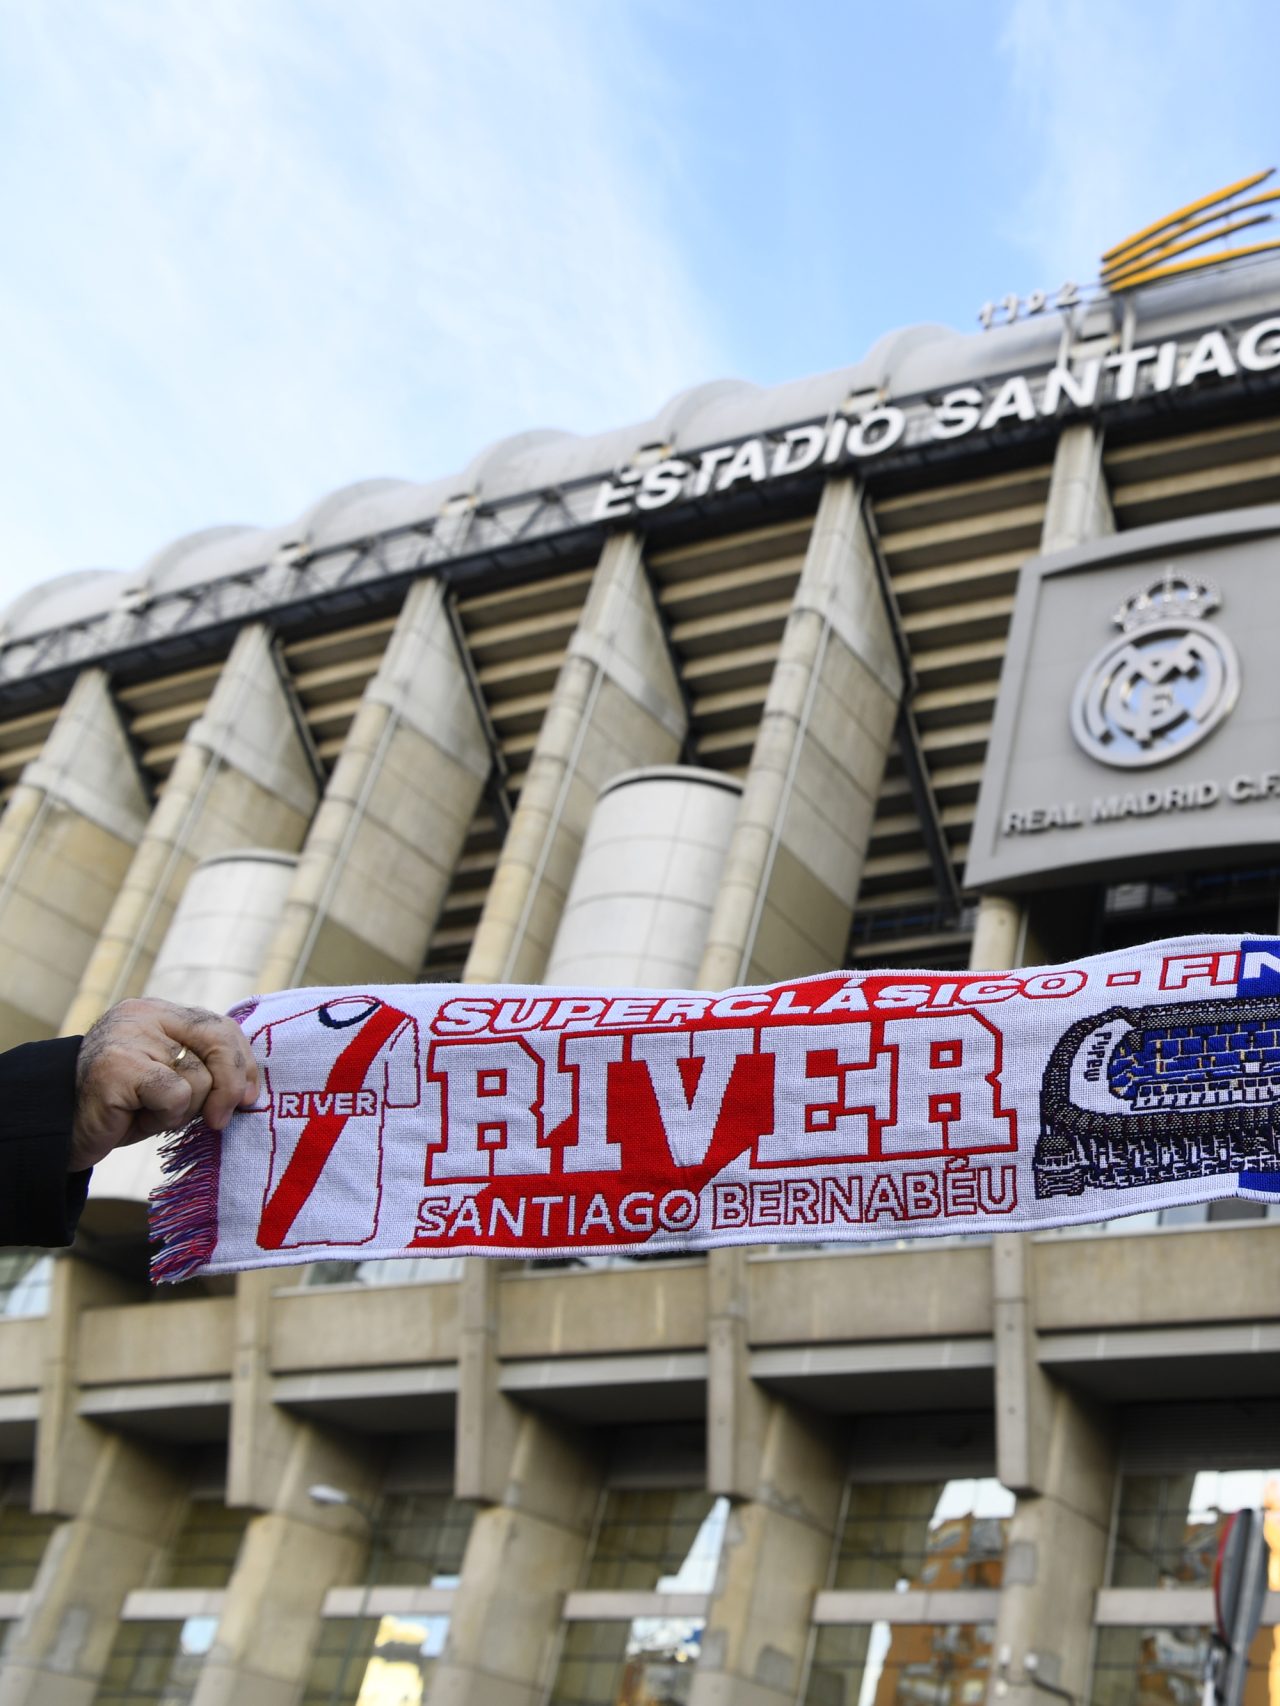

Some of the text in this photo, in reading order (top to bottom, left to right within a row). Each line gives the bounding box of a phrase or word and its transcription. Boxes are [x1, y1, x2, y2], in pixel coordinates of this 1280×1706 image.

[590, 405, 906, 520] ESTADIO
[1004, 802, 1082, 836] REAL
[1091, 780, 1218, 823] MADRID
[431, 977, 1085, 1035] SUPERCLÁSICO
[278, 1090, 377, 1118] RIVER
[427, 1009, 1017, 1184] RIVER
[415, 1157, 1018, 1239] SANTIAGO BERNABÉU
